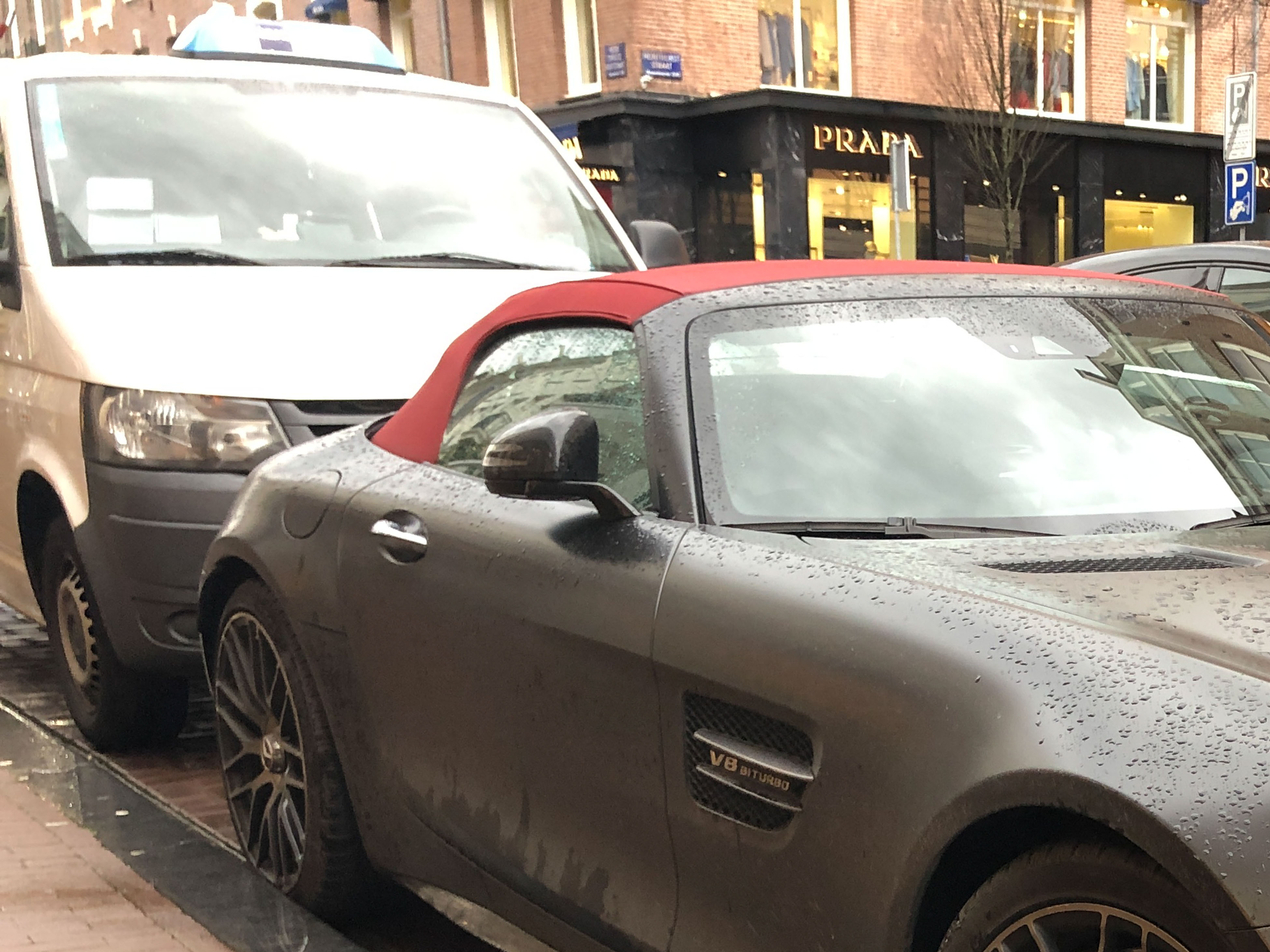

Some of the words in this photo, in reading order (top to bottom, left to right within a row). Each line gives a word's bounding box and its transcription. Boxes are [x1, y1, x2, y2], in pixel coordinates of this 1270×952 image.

[1233, 84, 1246, 106] P
[582, 167, 620, 181] RADA
[1232, 167, 1248, 199] P
[710, 750, 738, 772] V8
[740, 765, 790, 791] BITURBO
